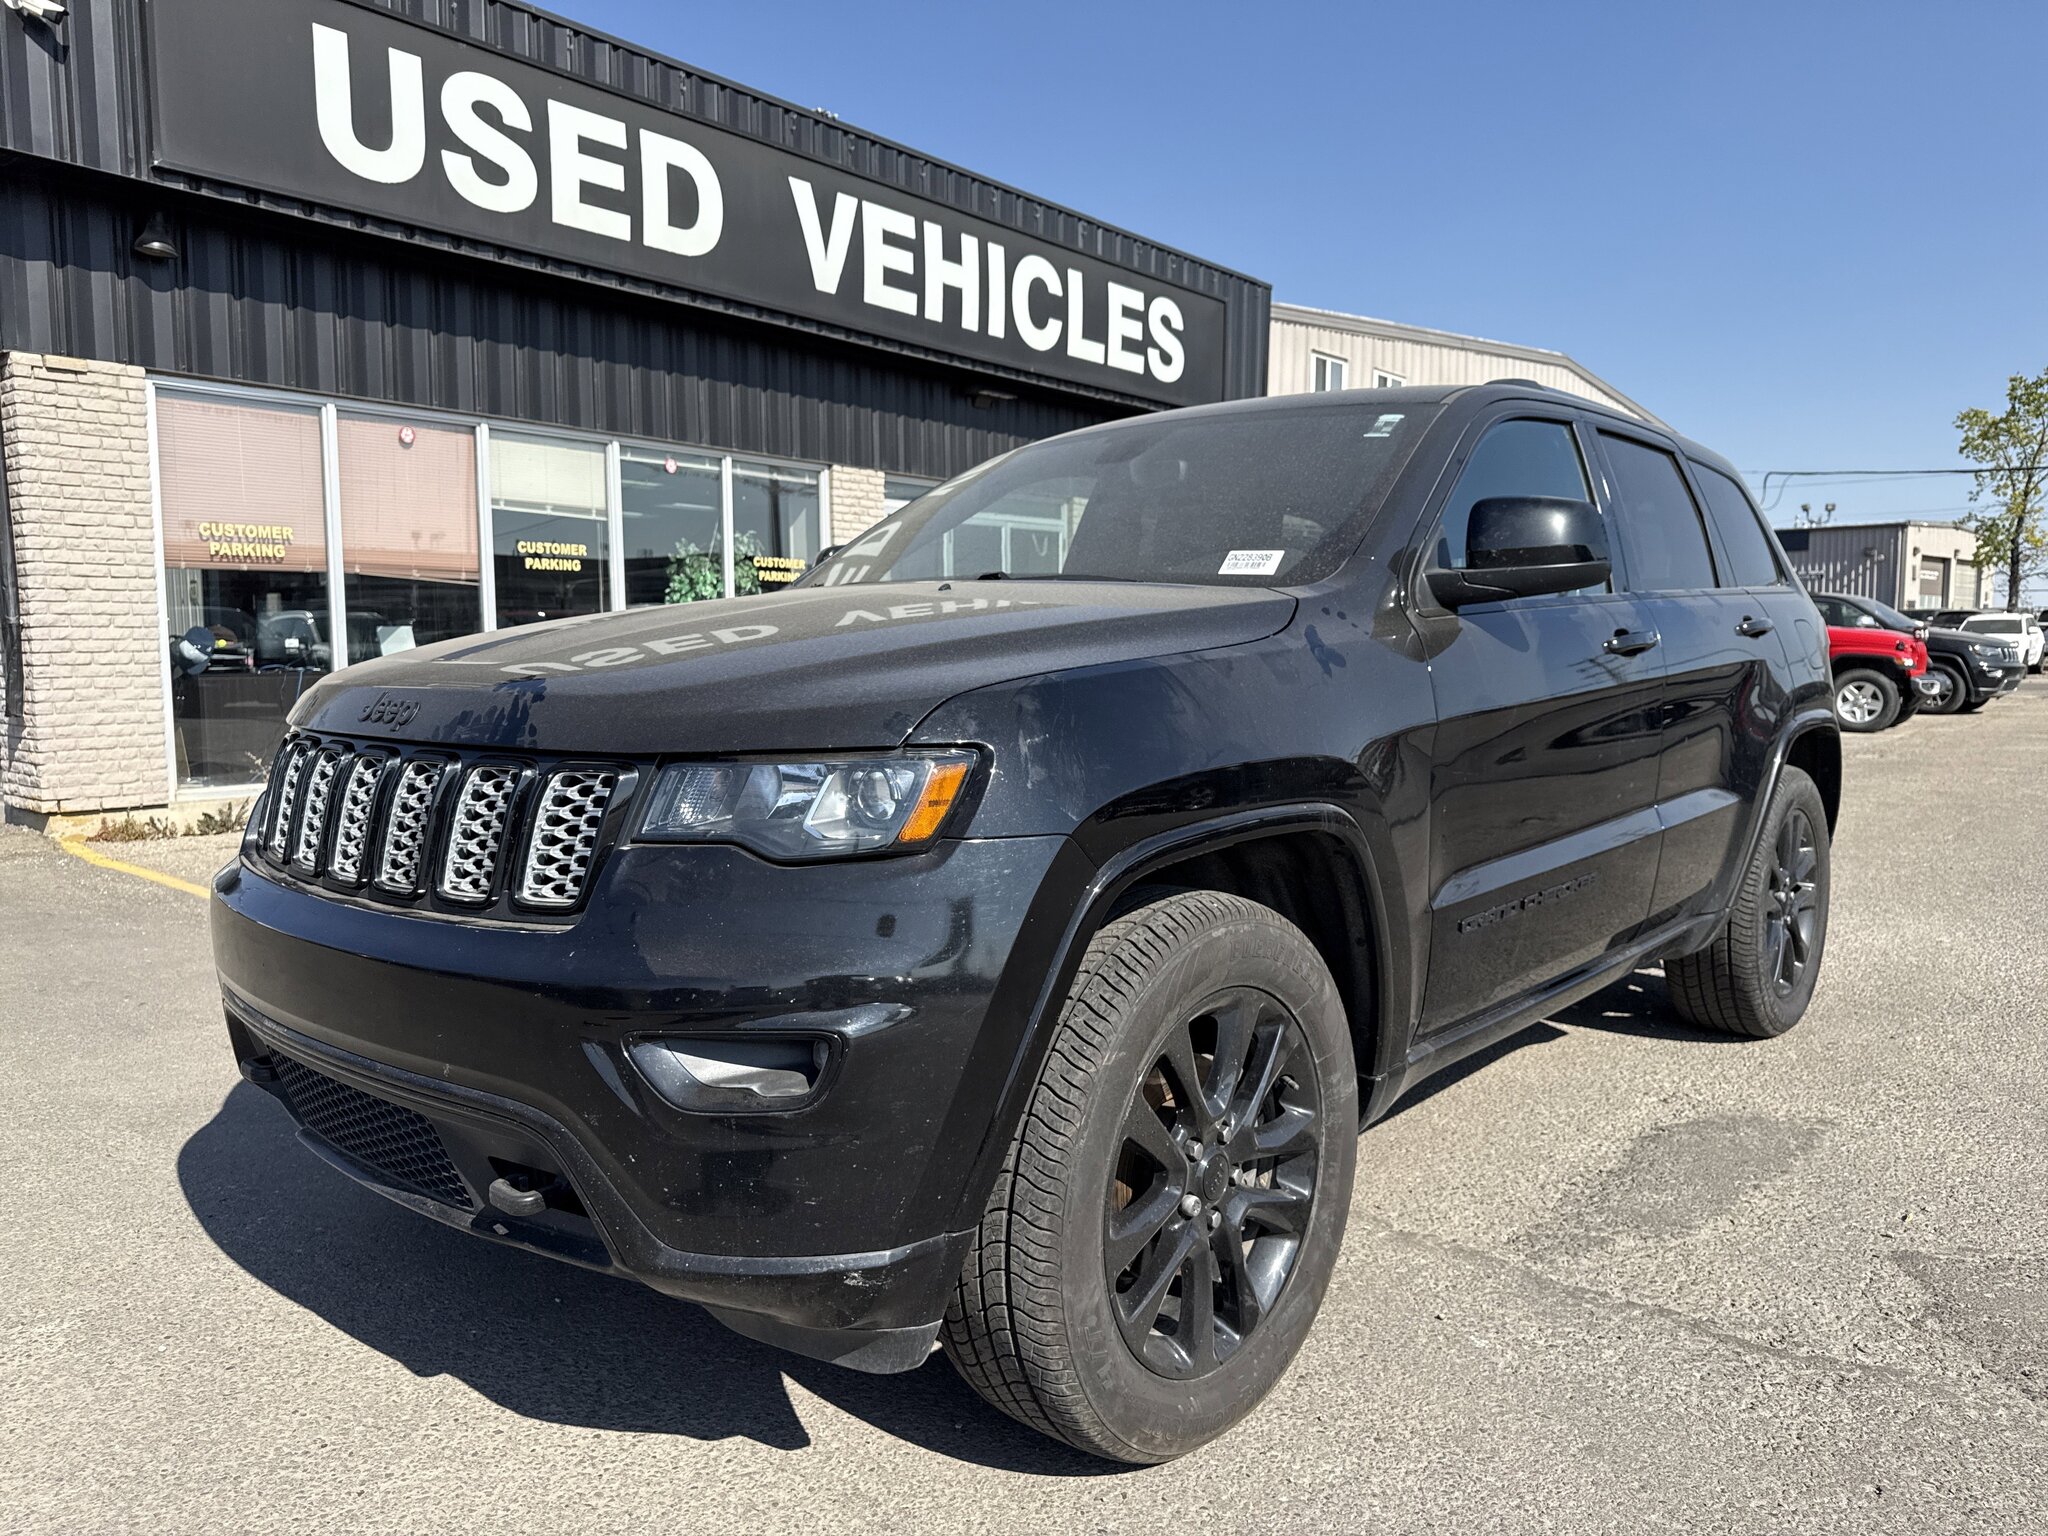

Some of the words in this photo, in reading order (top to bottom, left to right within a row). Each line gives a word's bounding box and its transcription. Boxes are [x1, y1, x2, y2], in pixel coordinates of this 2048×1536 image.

[312, 22, 724, 257] USED
[788, 175, 1185, 383] VEHICLES
[199, 522, 293, 539] CUSTOMER
[210, 542, 285, 557] PARKING
[517, 541, 587, 556] CUSTOMER
[524, 557, 581, 571] PARKING
[753, 556, 805, 569] CUSTOMER
[358, 691, 421, 732] Jeep
